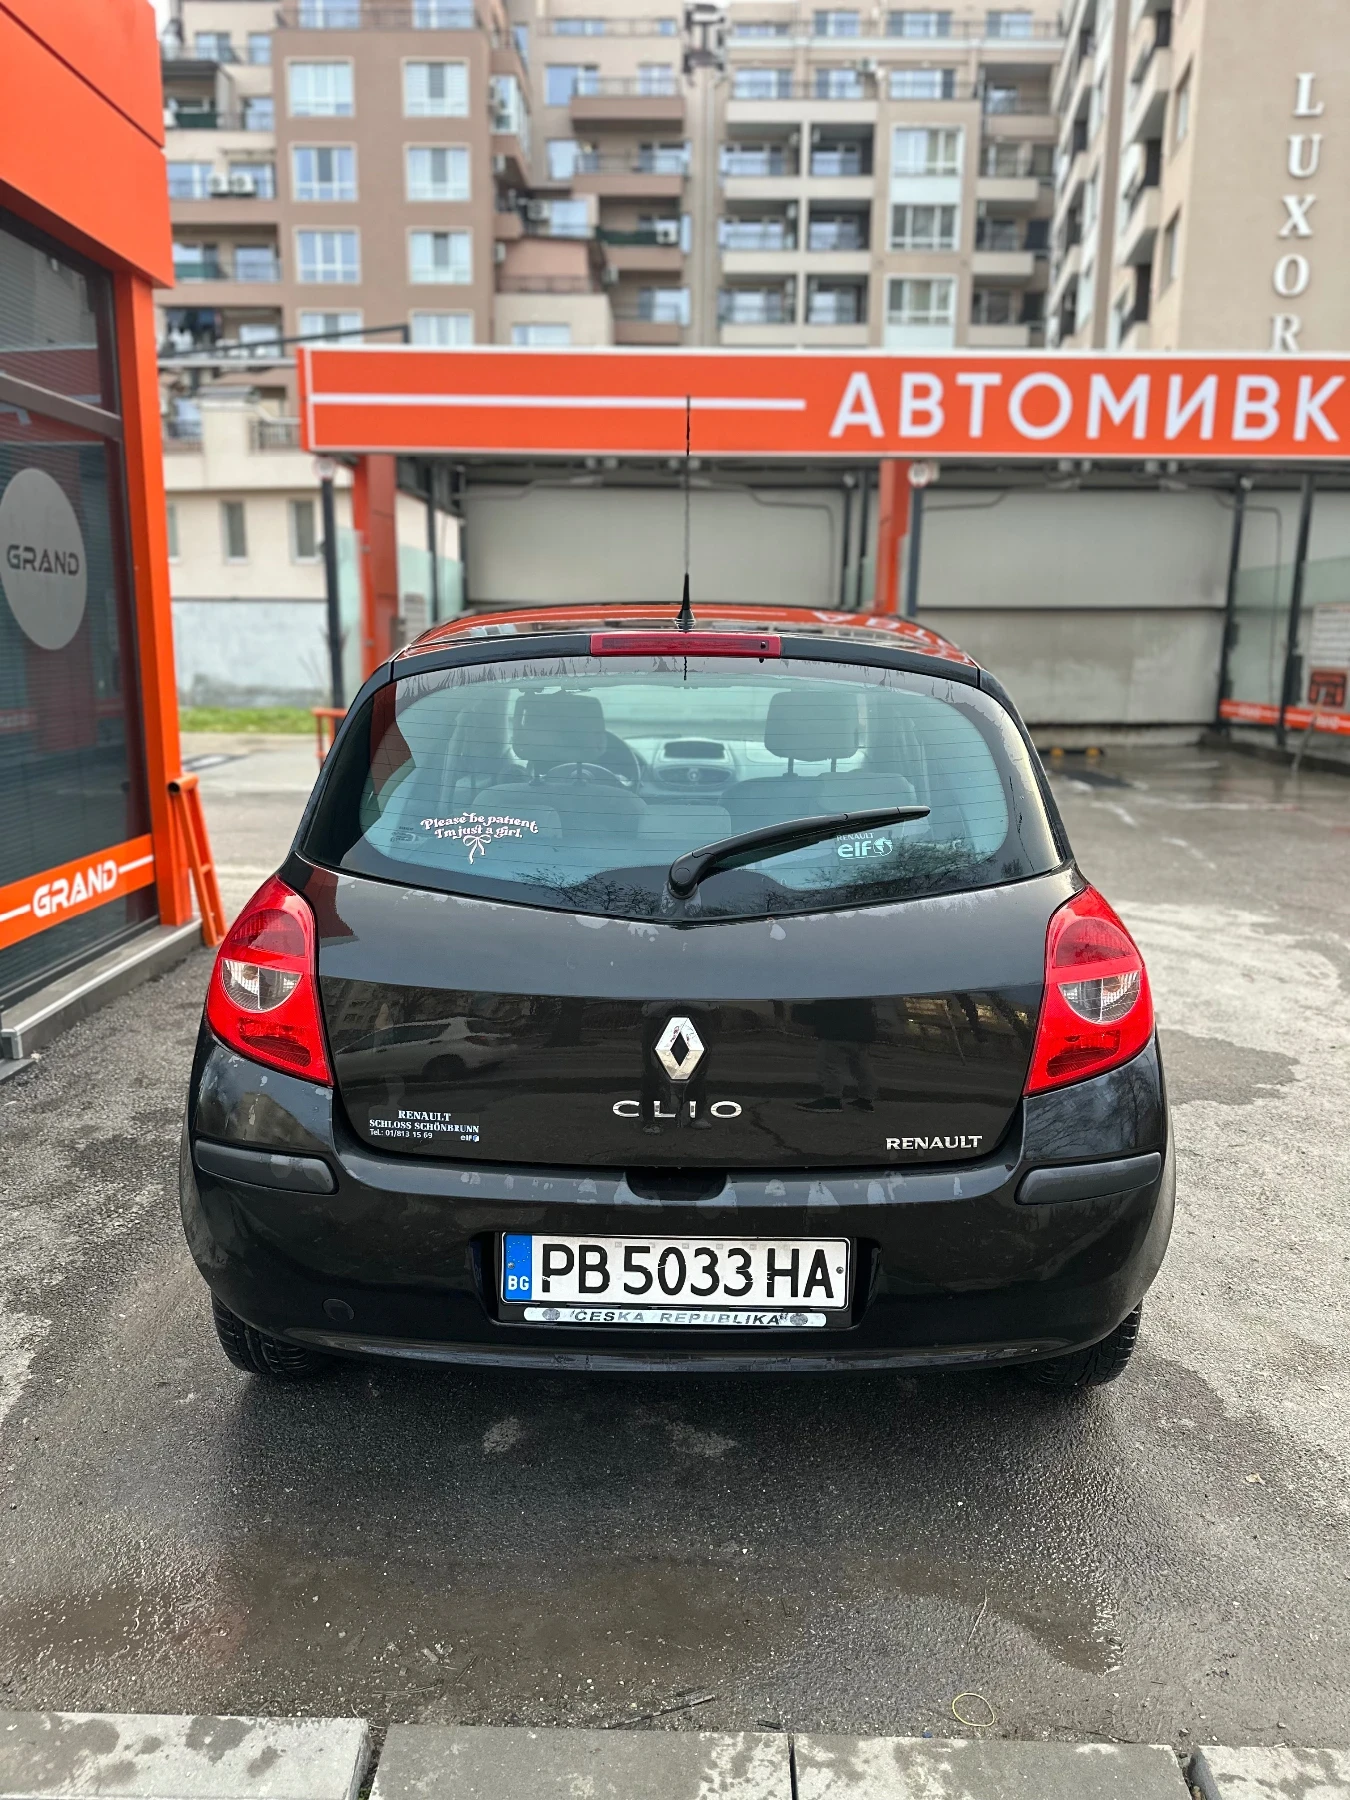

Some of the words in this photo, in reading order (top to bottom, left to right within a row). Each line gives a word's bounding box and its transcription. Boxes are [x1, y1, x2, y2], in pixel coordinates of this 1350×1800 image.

[1269, 72, 1325, 352] LUXOR
[829, 372, 1346, 442] АВТОМИВК
[7, 544, 80, 576] GRAND
[420, 817, 467, 830] Please
[463, 812, 485, 823] be
[452, 825, 482, 839] just
[485, 827, 493, 835] a
[836, 833, 874, 841] RENAULT
[837, 841, 872, 858] elf
[33, 859, 118, 918] GRAND
[397, 1109, 452, 1121] RENAULT
[612, 1100, 742, 1118] CLIO
[369, 1119, 412, 1129] SCHLOSS
[414, 1121, 479, 1133] SCHÖNBRUNN
[385, 1129, 410, 1138] 01/813
[423, 1131, 433, 1139] 69
[886, 1135, 982, 1150] RENAULT
[541, 1243, 611, 1295] PB
[623, 1245, 754, 1297] 5033
[766, 1247, 834, 1299] HA
[507, 1275, 530, 1292] BG
[659, 1312, 781, 1325] REPUBLIKA
